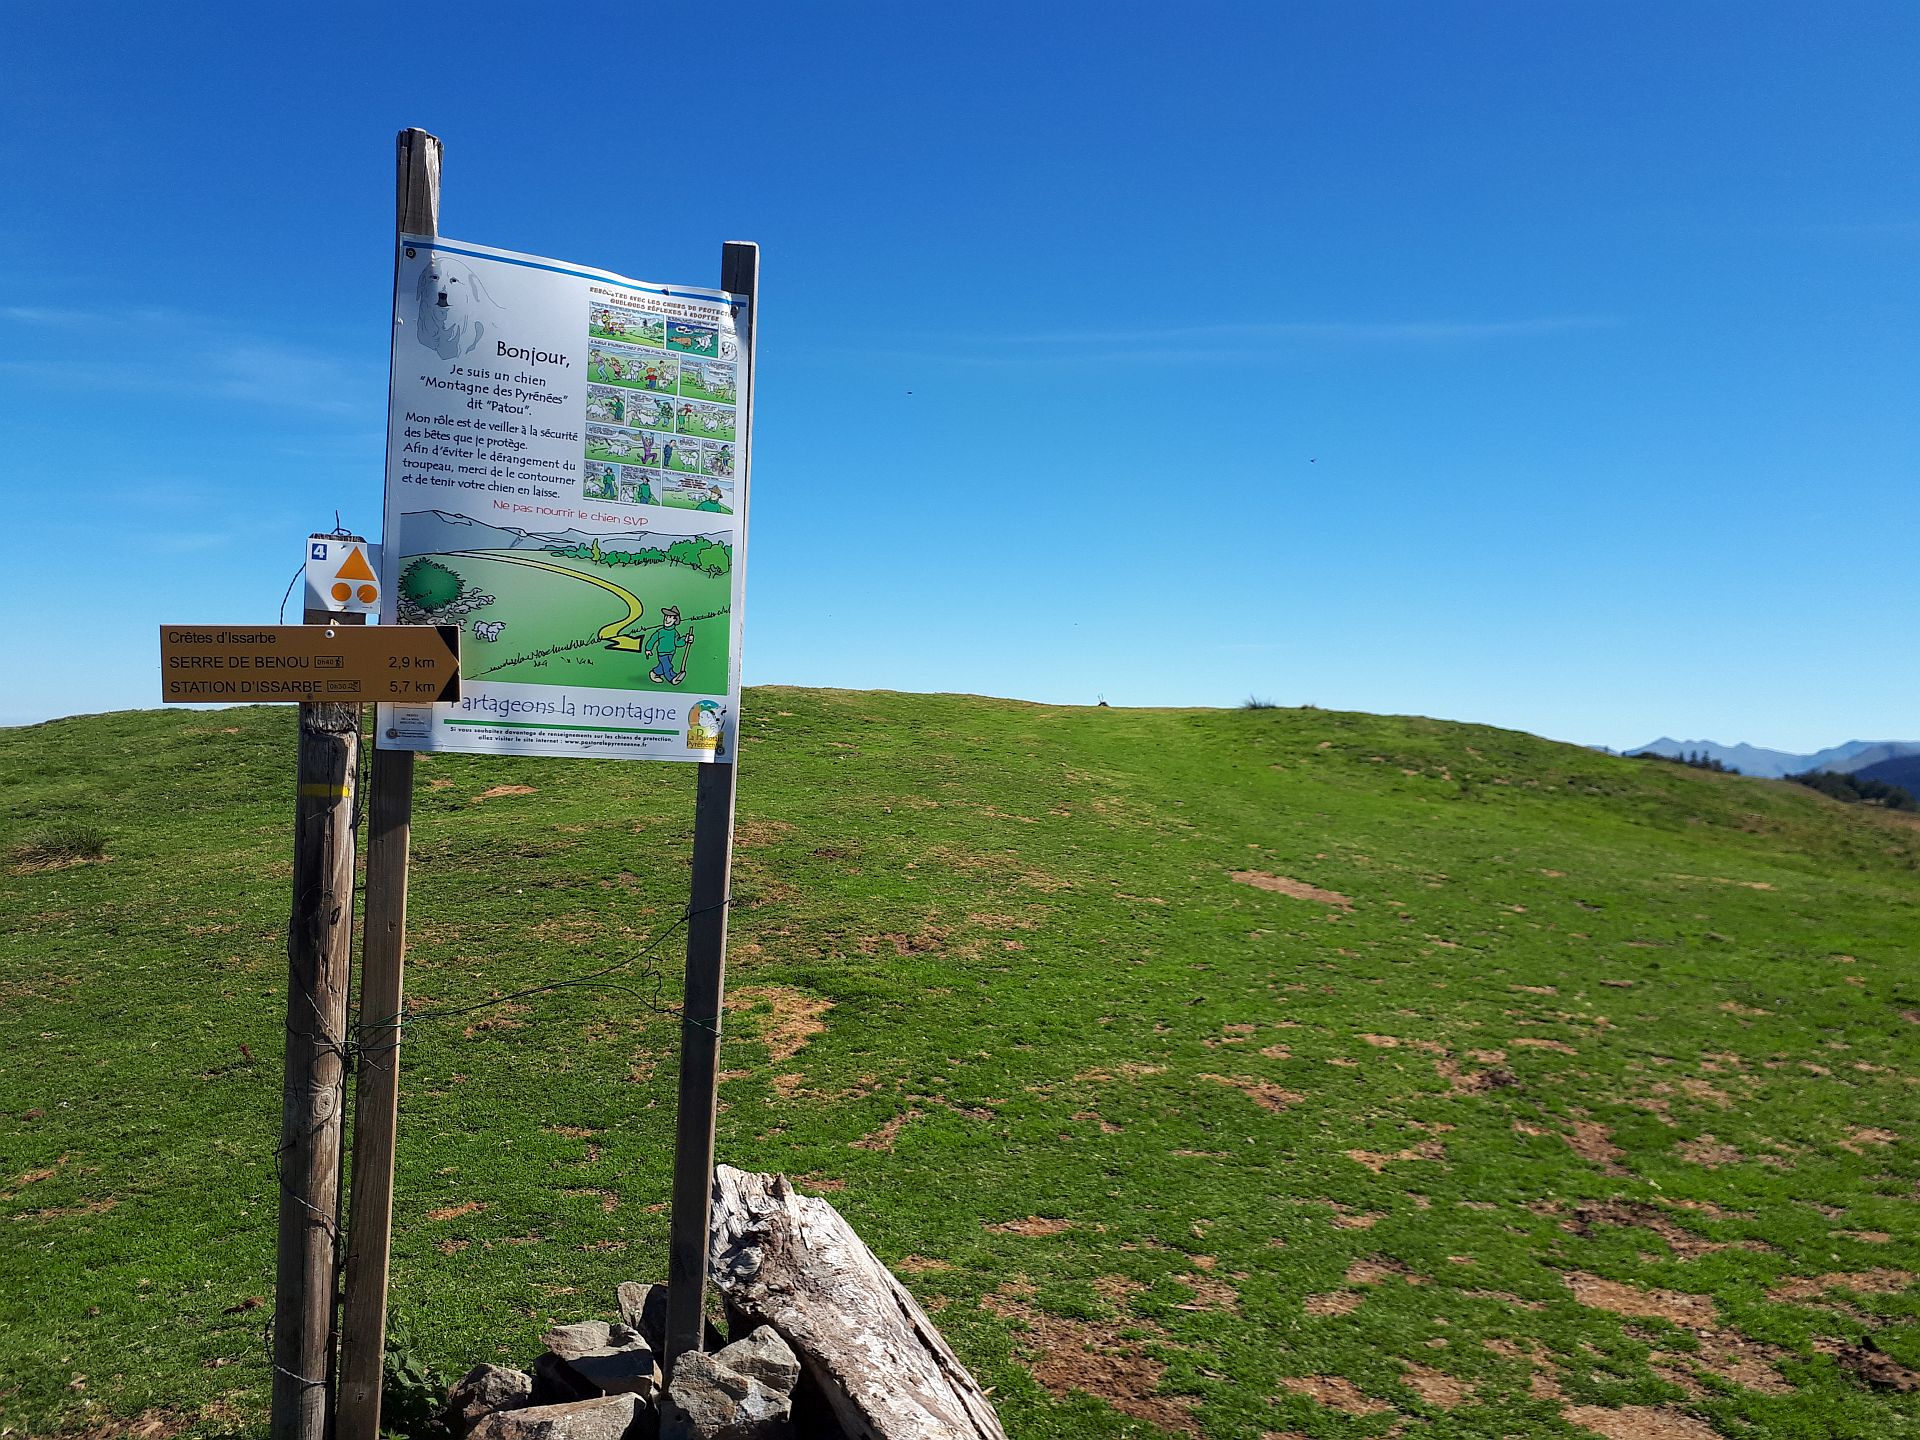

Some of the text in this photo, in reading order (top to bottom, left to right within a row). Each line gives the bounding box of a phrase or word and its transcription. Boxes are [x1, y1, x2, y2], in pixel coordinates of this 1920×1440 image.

[497, 340, 570, 368] Bonjour,
[450, 364, 546, 387] Je suis un chien
[493, 384, 512, 397] des
[467, 397, 483, 410] dit
[406, 412, 430, 424] Mon
[434, 414, 454, 426] rôle
[456, 418, 471, 428] est
[474, 418, 486, 430] de
[488, 421, 519, 434] veiller
[521, 425, 526, 435] à
[530, 425, 538, 436] la
[540, 429, 578, 441] sécurité
[404, 427, 528, 451] des bêtes que je protège.
[403, 442, 428, 454] Afin
[432, 445, 474, 458] d'éviter
[477, 448, 486, 460] le
[490, 451, 560, 467] dérangement
[562, 460, 576, 471] du
[402, 458, 576, 485] troupeau, merci de le contourner
[402, 474, 560, 499] et de tenir votre chien en laisse.
[493, 500, 649, 526] Ne pas nourrir le chien SVP
[314, 545, 325, 558] 4
[168, 631, 276, 644] Crêtes d'Issarbe
[169, 656, 224, 668] SERRE
[229, 656, 250, 668] DE
[254, 656, 309, 668] BENOU
[388, 656, 435, 670] 2,9 km
[170, 681, 236, 693] STATION
[241, 681, 322, 693] D'ISSARBE
[389, 681, 435, 694] 5,7 km
[451, 694, 676, 724] artageons la montagne
